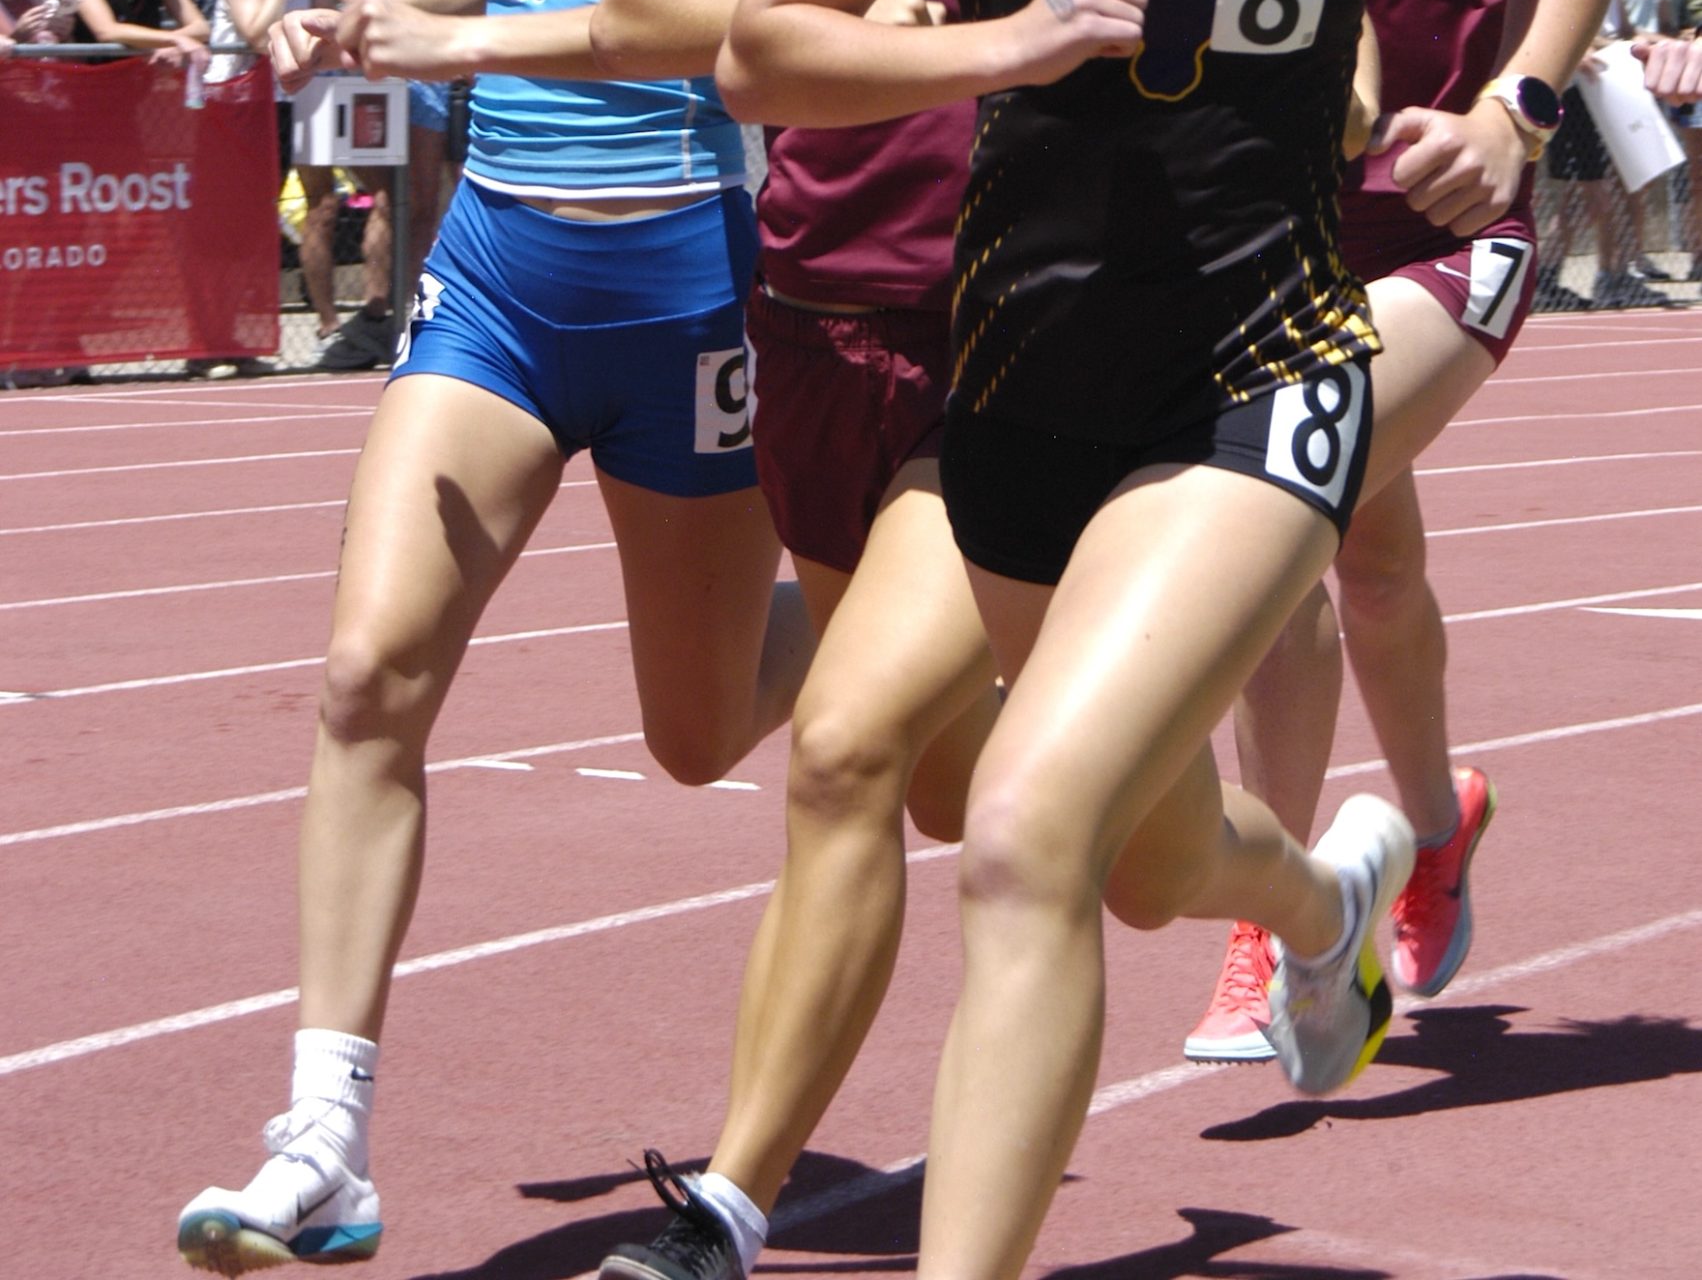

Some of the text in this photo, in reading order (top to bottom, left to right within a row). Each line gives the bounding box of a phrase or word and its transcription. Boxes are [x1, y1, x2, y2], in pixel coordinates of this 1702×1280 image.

[0, 161, 192, 216] rs Roost
[0, 244, 107, 271] ORADO
[1478, 241, 1526, 327] 7
[714, 353, 751, 448] 9
[1291, 365, 1352, 488] 8
